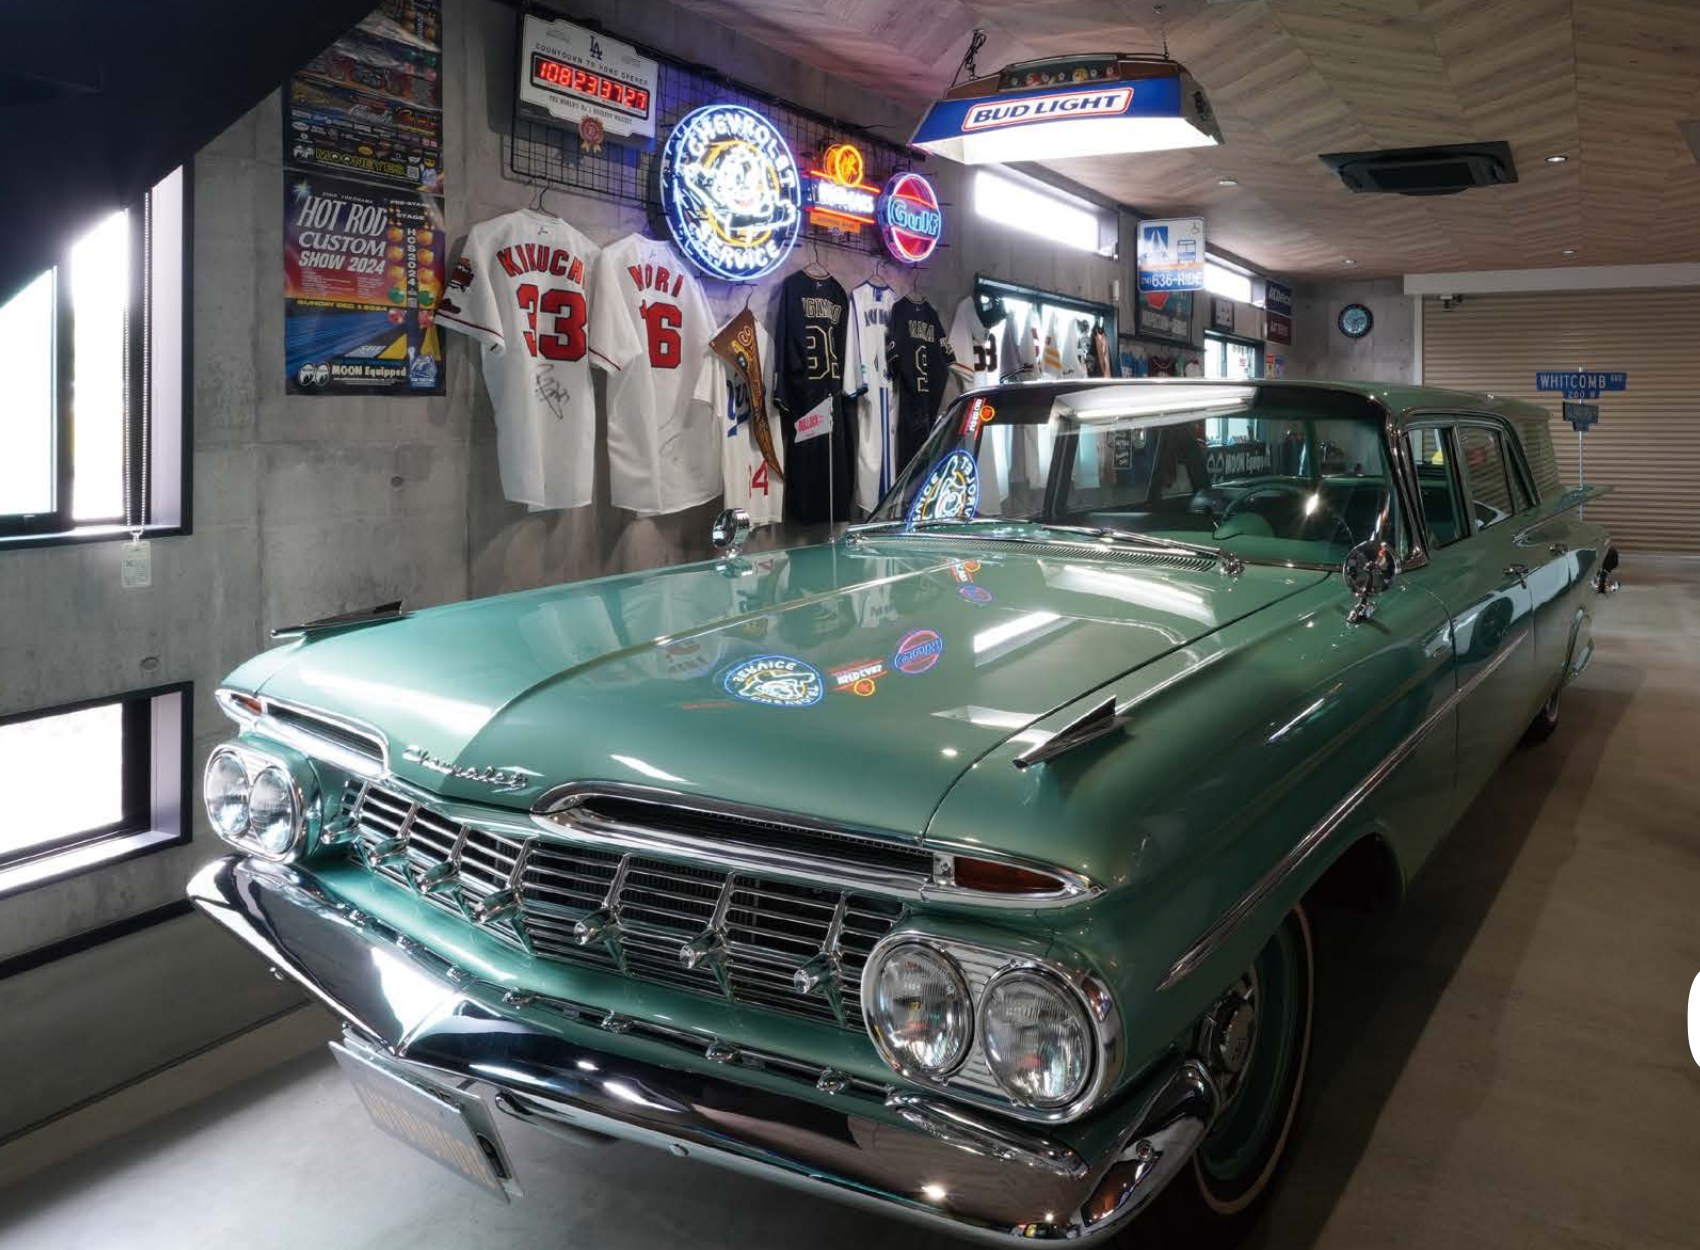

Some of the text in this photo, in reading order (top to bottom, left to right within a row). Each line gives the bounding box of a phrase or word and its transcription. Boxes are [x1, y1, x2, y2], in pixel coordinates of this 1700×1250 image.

[589, 35, 603, 60] LA
[536, 42, 583, 64] COUNTDOWN
[599, 64, 619, 77] HOME
[621, 72, 648, 86] OPENER
[574, 72, 598, 96] 23
[600, 80, 624, 104] 37
[973, 94, 1122, 124] BUD LIGHT
[315, 147, 405, 176] MOONEYES
[296, 195, 388, 237] HOT ROD
[891, 199, 939, 235] Gulf
[298, 231, 387, 257] CUSTOM
[298, 250, 387, 275] SHOW 2024
[1151, 271, 1203, 288] 636-RIDE
[639, 299, 683, 369] 6
[331, 364, 407, 378] MOON Equipped
[1540, 374, 1622, 389] WHITCOMB AVE
